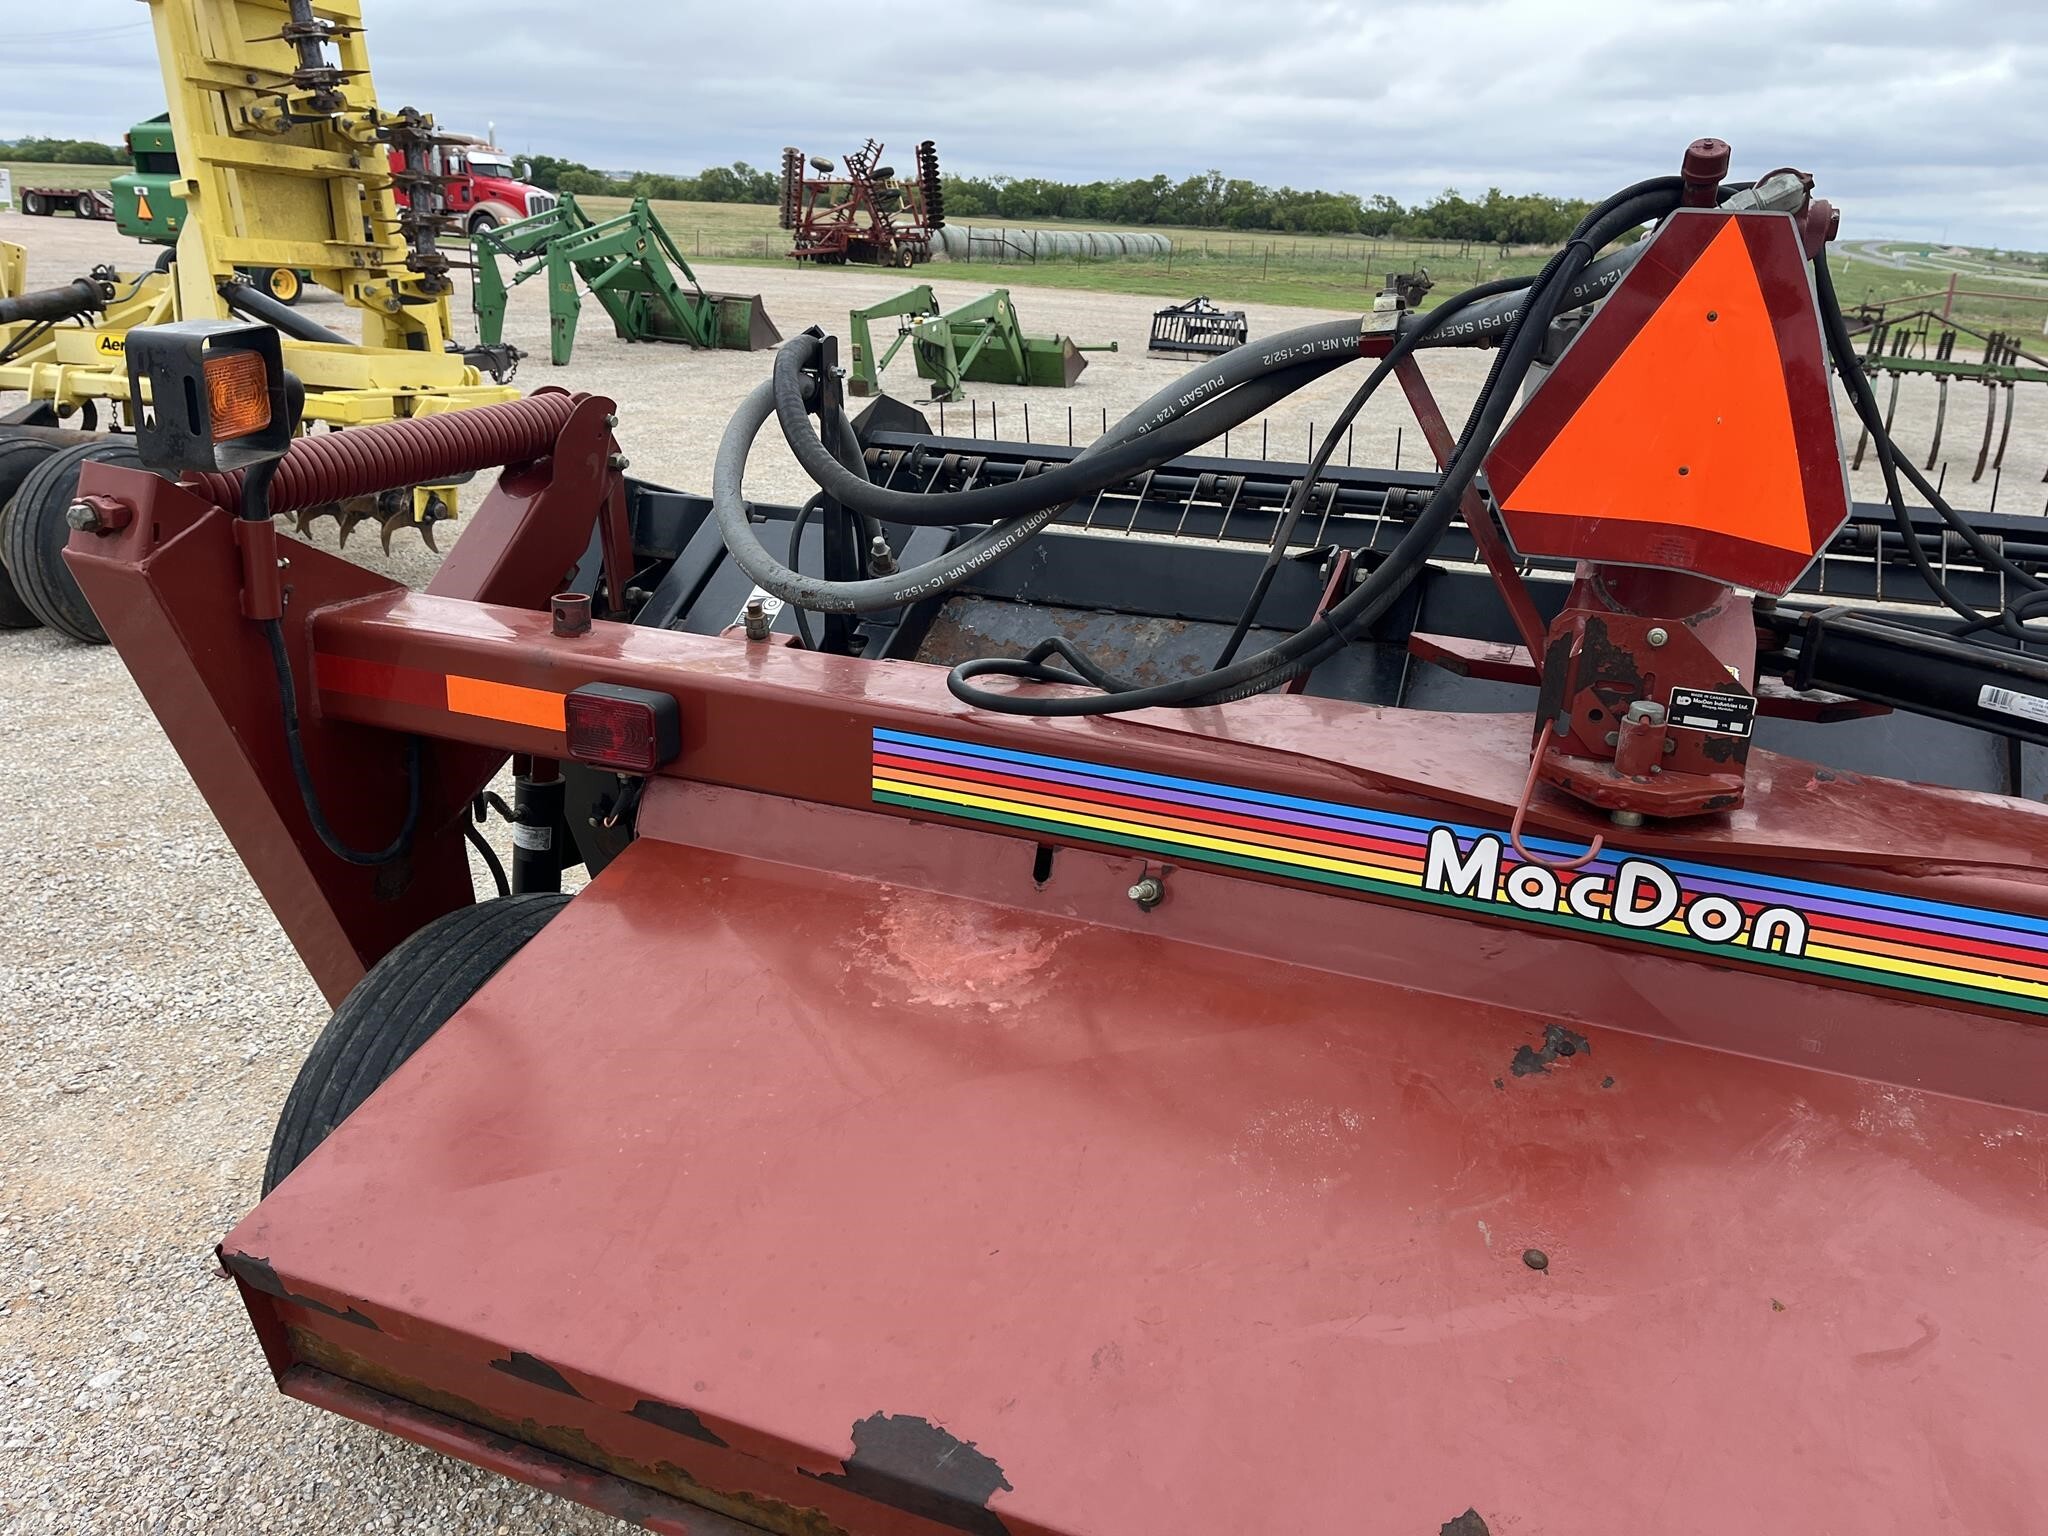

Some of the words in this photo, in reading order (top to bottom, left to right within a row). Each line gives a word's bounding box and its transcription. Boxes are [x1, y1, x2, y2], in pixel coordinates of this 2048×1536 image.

[1478, 314, 1501, 330] PSI
[101, 336, 126, 351] Aer
[1318, 338, 1339, 351] NR.
[1178, 374, 1226, 407] PULSAR
[966, 534, 1015, 568] USMSHA
[944, 564, 967, 581] NR.
[1692, 697, 1713, 706] MacDon
[1713, 700, 1738, 709] Industries
[1424, 826, 1808, 957] MacDon
